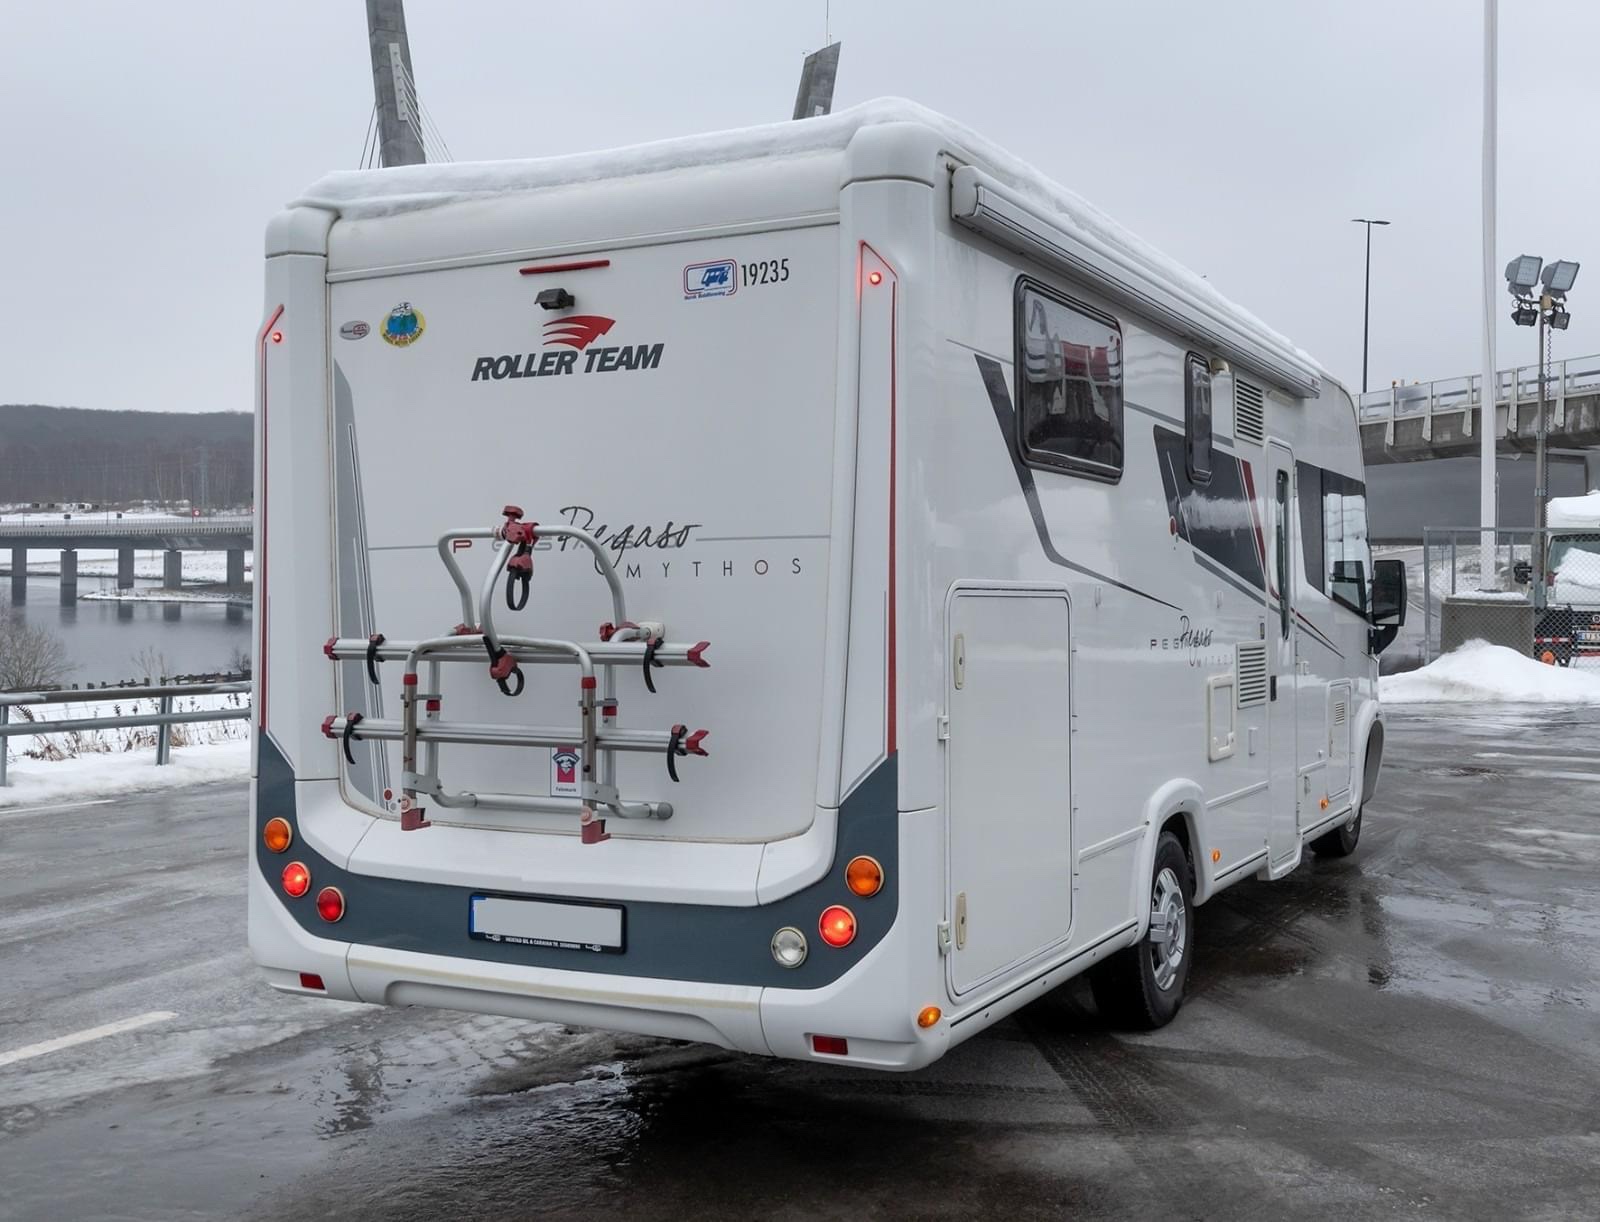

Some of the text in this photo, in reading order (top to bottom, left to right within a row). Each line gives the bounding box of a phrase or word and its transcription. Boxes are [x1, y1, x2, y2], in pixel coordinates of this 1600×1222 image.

[741, 258, 790, 287] 19235
[471, 343, 665, 381] ROLLER TEAM
[626, 558, 802, 579] MYTHOS
